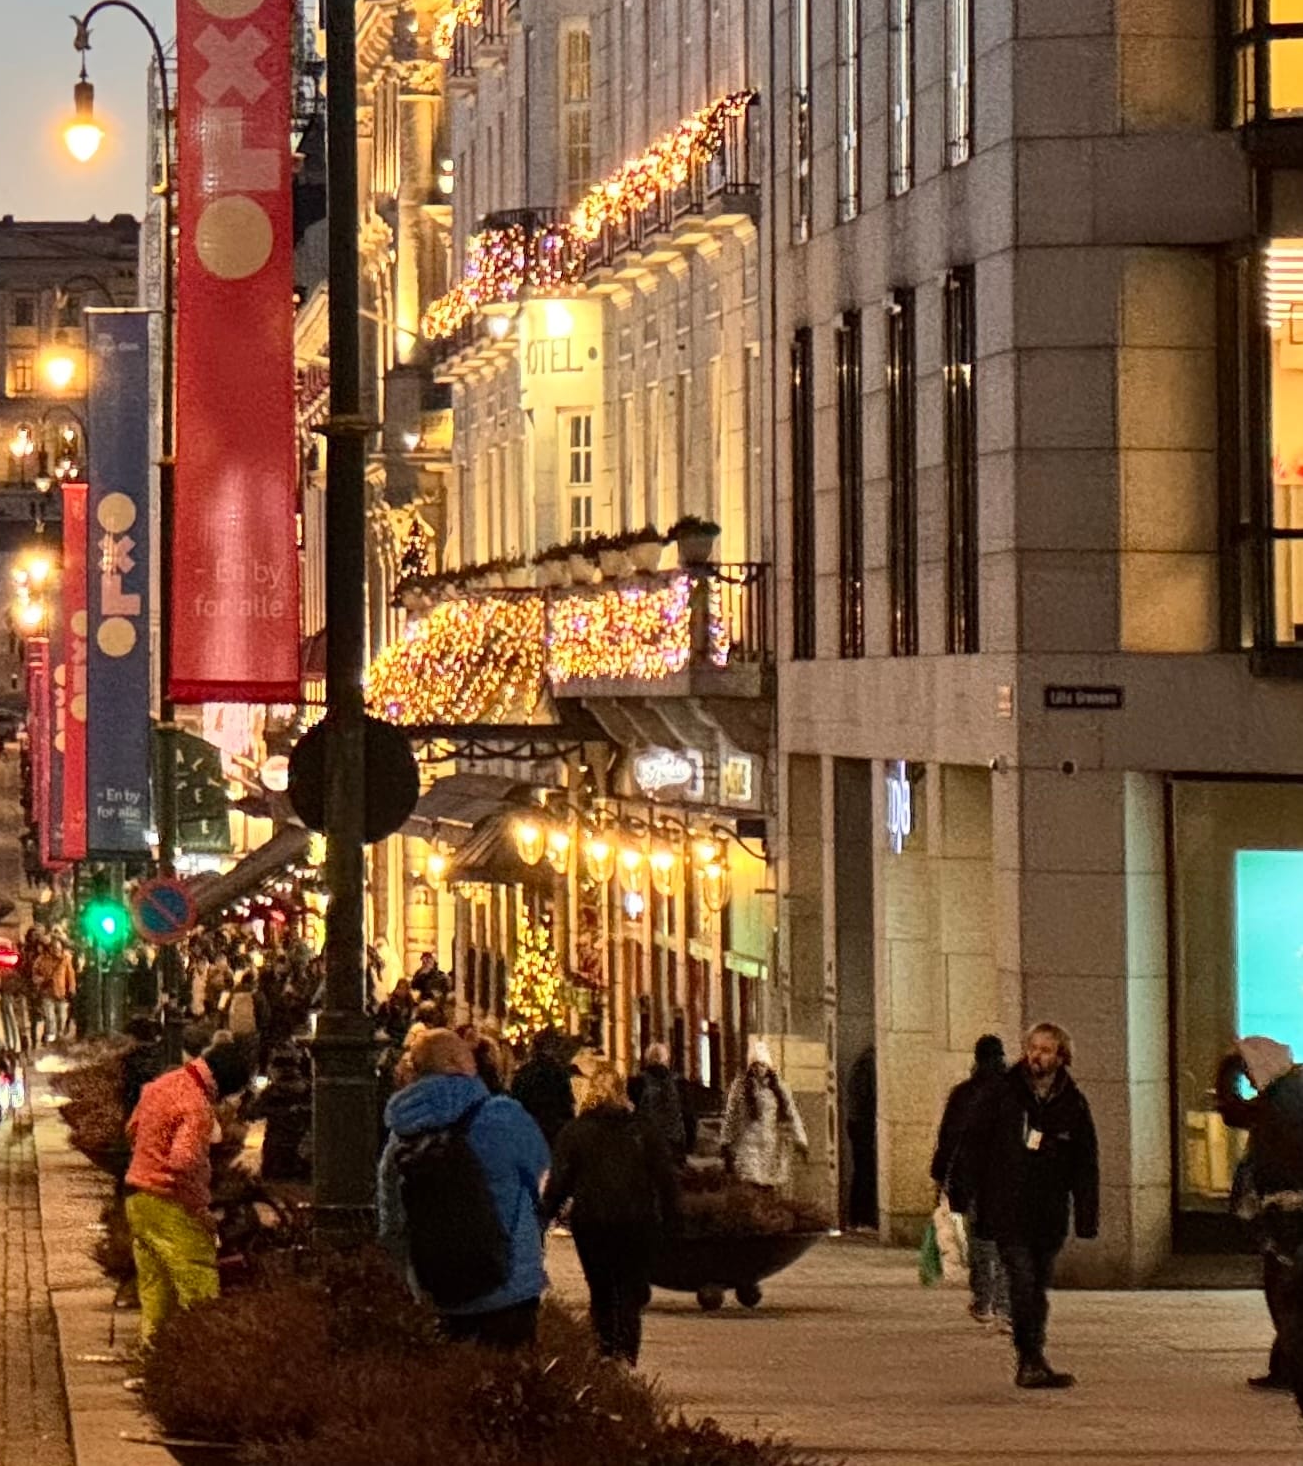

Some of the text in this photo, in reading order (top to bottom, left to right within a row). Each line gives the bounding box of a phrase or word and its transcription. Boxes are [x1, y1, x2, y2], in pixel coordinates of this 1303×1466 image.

[254, 558, 287, 588] by
[194, 593, 284, 618] for alle
